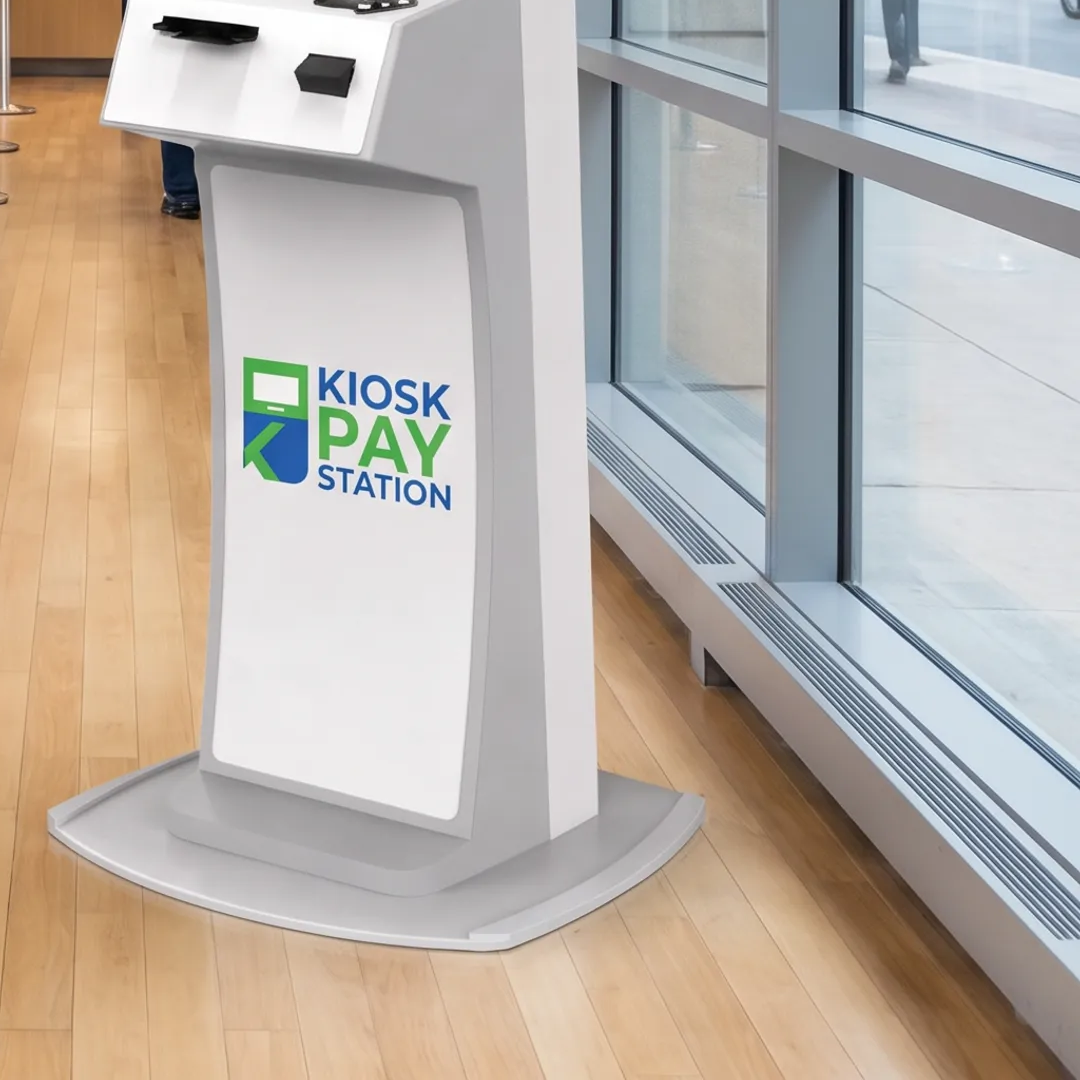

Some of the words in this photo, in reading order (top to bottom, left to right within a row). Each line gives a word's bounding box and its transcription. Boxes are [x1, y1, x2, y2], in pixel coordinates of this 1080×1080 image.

[318, 366, 451, 421] KIOSK
[318, 405, 452, 478] PAY
[318, 464, 451, 511] STATION
